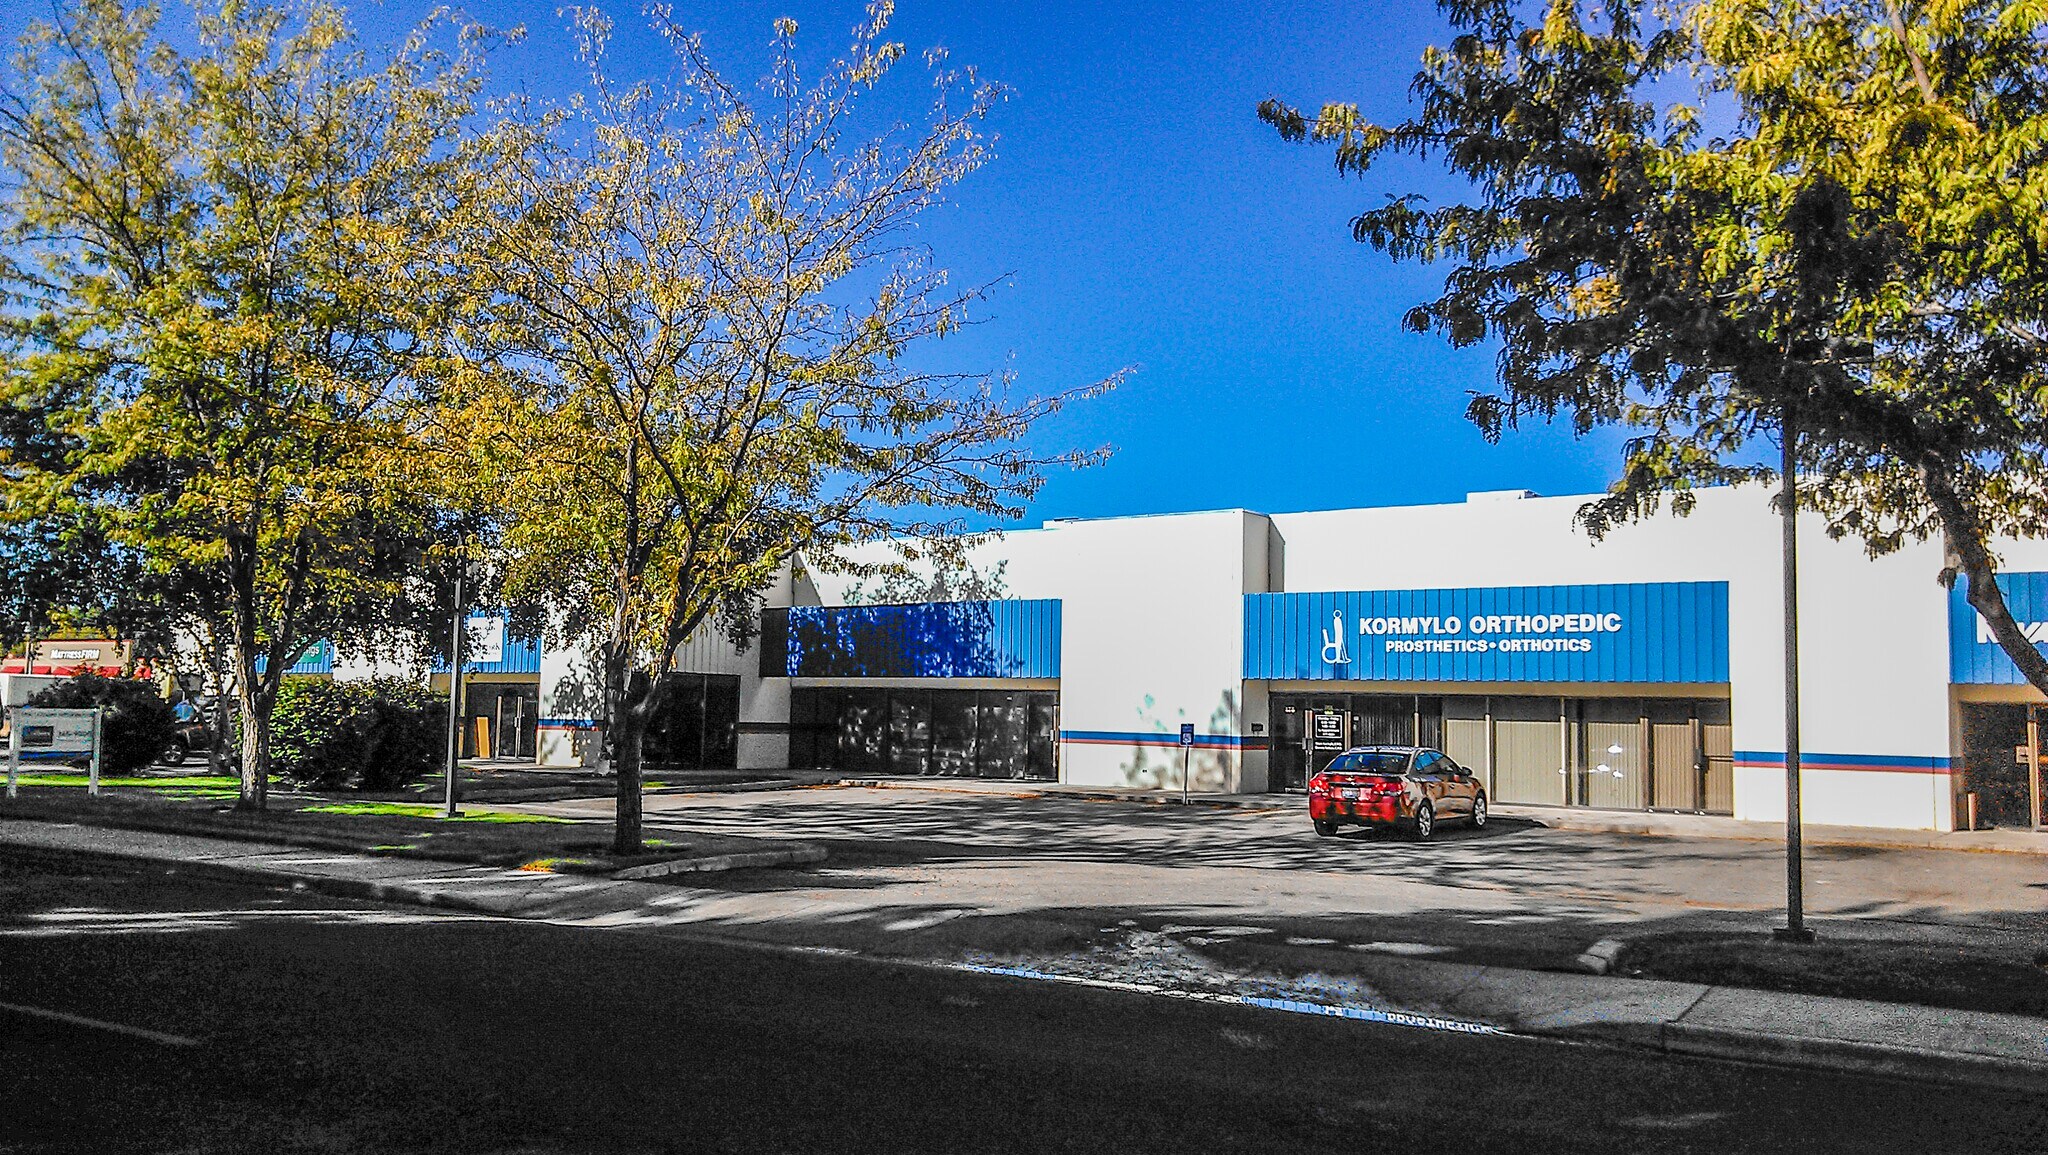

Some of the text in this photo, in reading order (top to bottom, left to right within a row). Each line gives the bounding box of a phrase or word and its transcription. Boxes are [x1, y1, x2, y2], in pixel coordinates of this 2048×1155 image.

[1359, 613, 1622, 635] KORMYLO ORTHOPEDIC
[1385, 638, 1592, 652] PROSTHETICS ORTHOTICS
